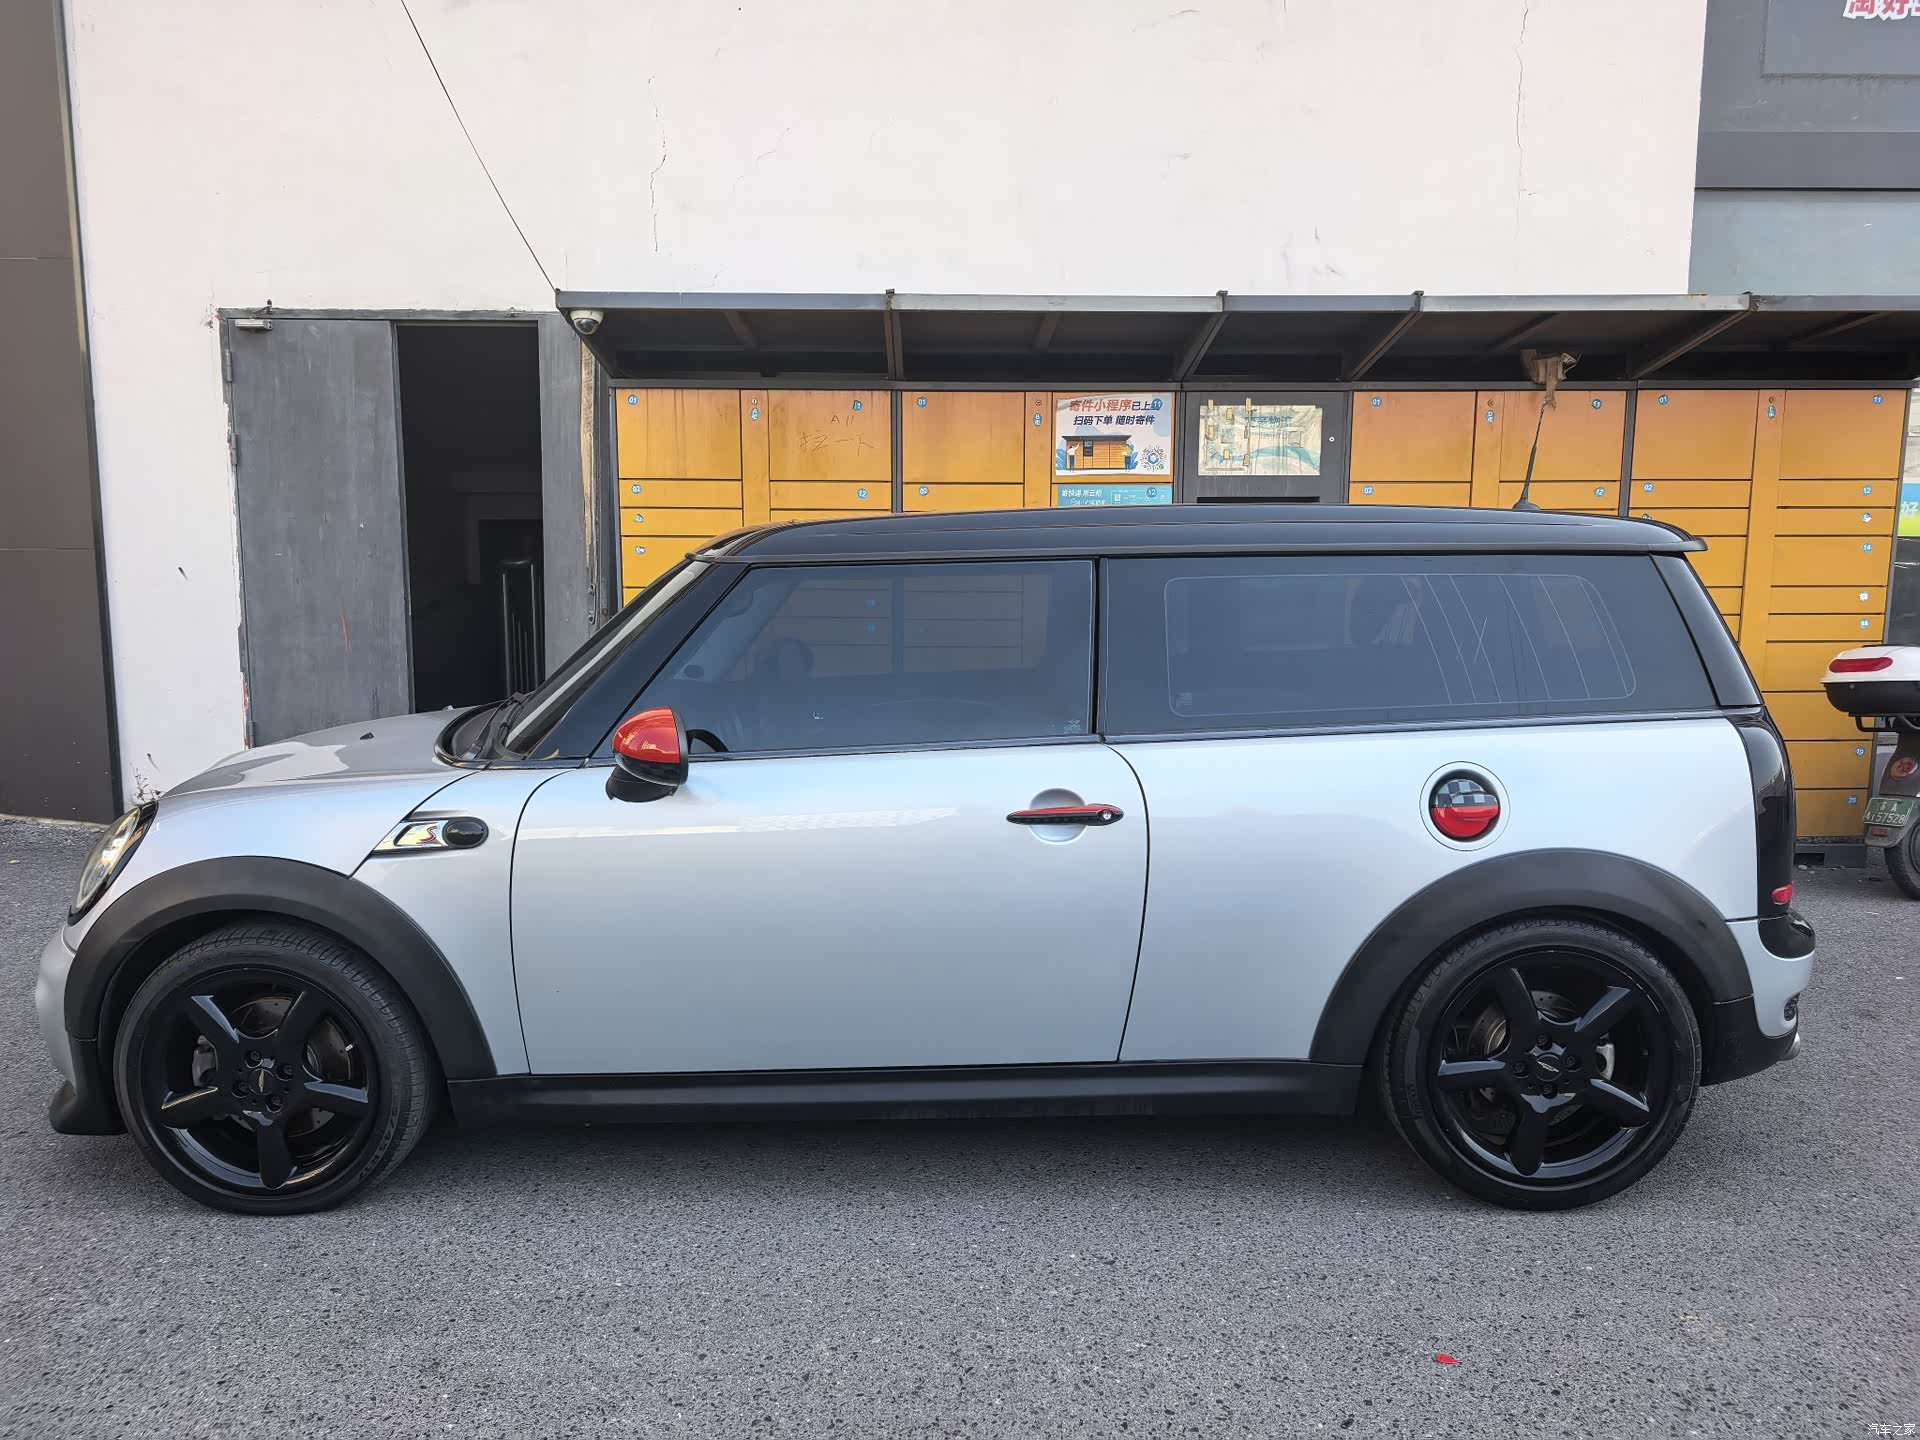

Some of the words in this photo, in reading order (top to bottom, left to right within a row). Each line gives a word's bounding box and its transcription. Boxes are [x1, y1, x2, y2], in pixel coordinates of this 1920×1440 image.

[1069, 399, 1159, 412] 寄件小程序已上
[1073, 415, 1113, 426] 扫码下单
[1115, 415, 1155, 426] 随时寄件
